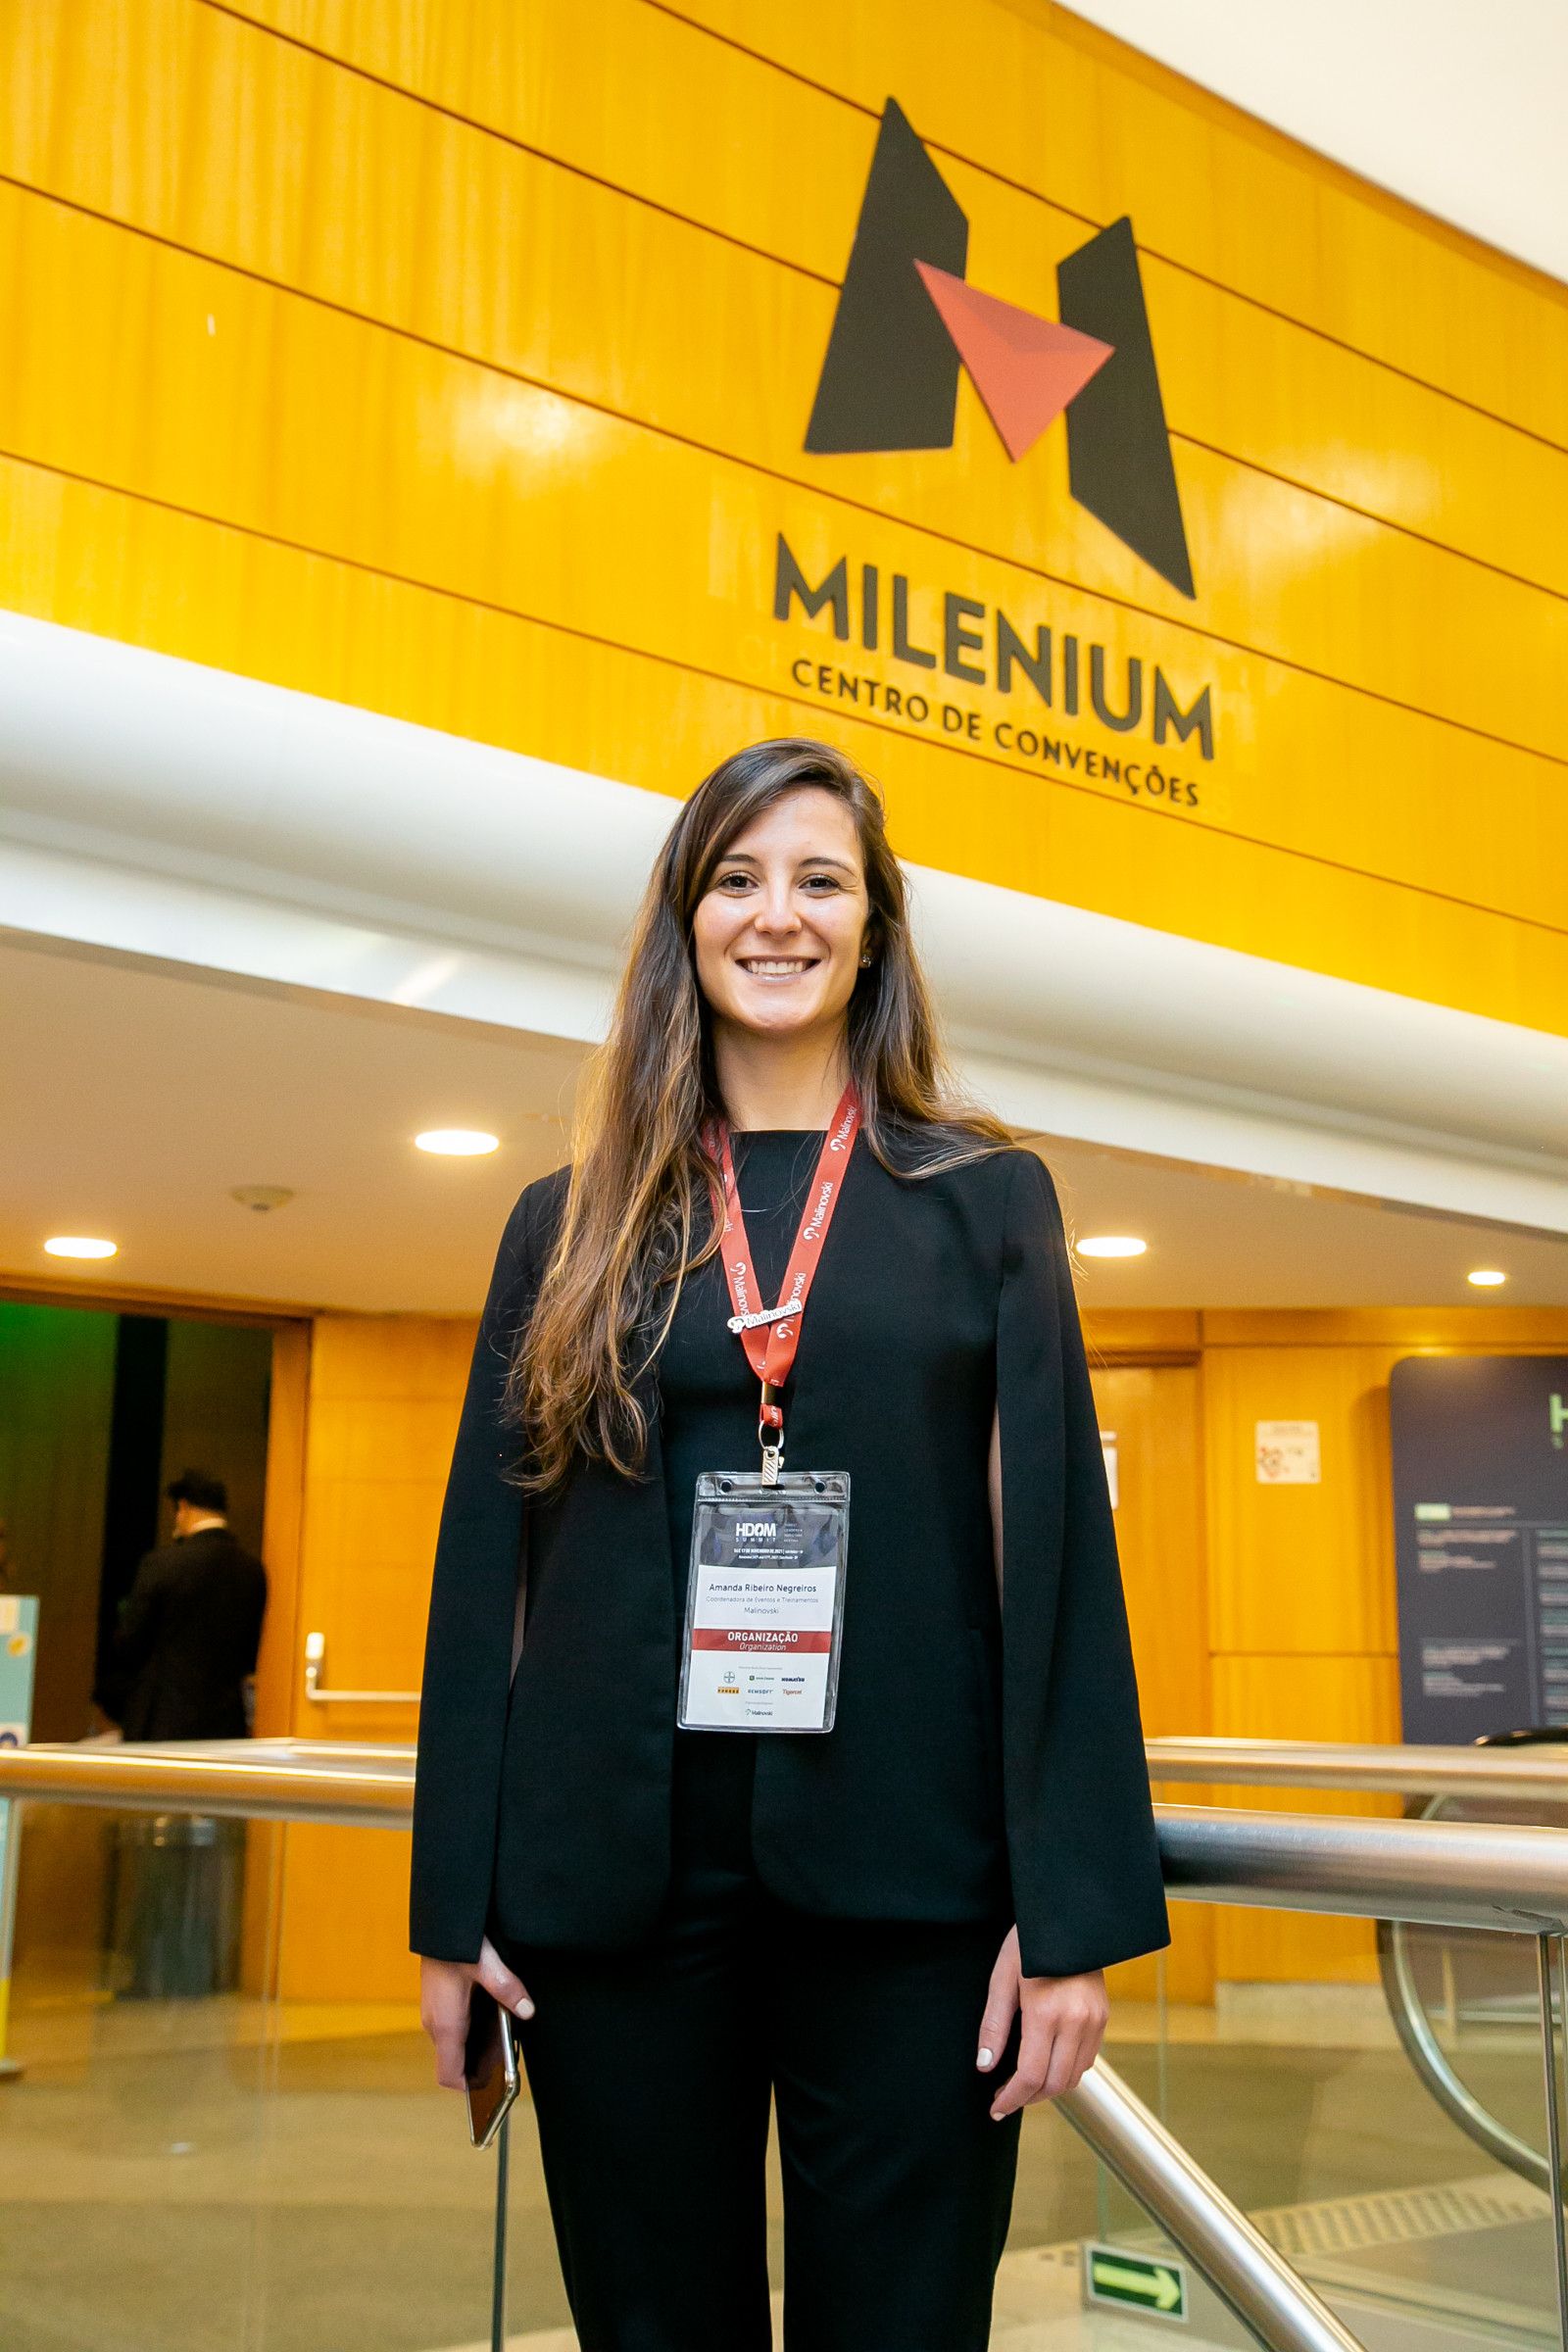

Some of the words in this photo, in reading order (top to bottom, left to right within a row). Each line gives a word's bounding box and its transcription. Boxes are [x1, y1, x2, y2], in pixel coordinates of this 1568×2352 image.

[774, 531, 1214, 761] MILENIUM
[792, 659, 930, 723] CENTRO
[942, 705, 981, 741] DE
[995, 722, 1200, 808] CONVENÇÕES
[836, 1105, 858, 1140] Malinovski
[810, 1182, 834, 1228] Malinovski
[735, 1522, 776, 1537] HDOM
[709, 1583, 743, 1592] Amanda
[745, 1583, 774, 1592] Ribeiro
[776, 1584, 817, 1594] Negreiros
[744, 1606, 780, 1615] Malinovski
[727, 1631, 799, 1644] ORGANIZAÇÃO
[739, 1642, 787, 1652] Organization
